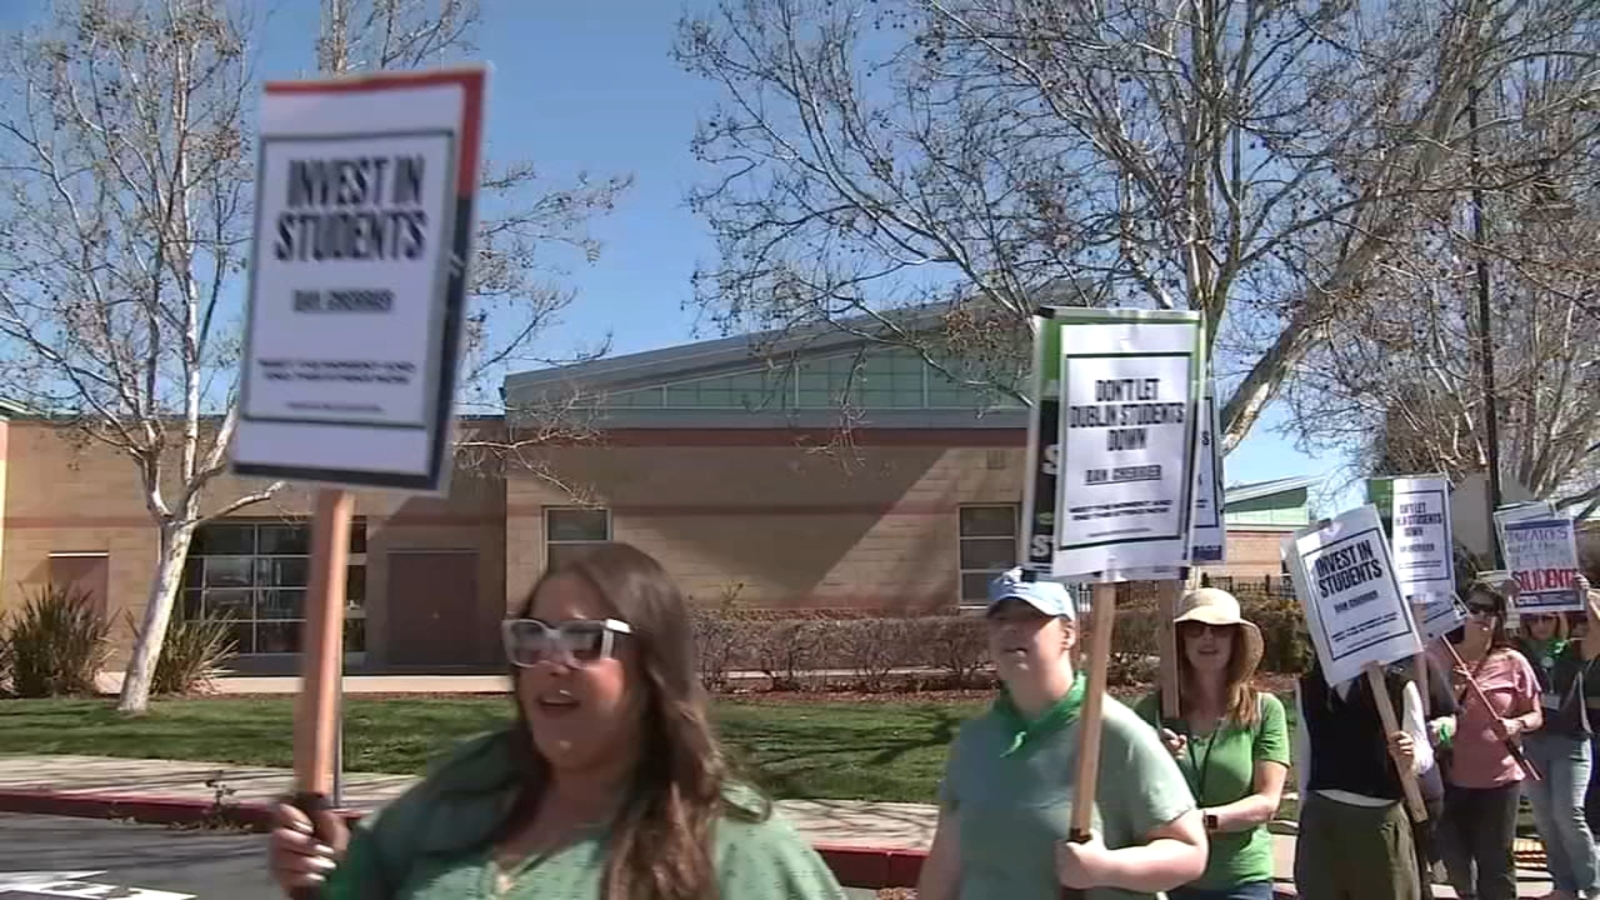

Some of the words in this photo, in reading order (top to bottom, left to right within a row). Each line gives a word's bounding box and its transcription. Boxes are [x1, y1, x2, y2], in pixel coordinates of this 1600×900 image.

[287, 158, 389, 206] INVEST
[393, 155, 426, 204] IN
[275, 211, 429, 261] STUDENTS
[1095, 379, 1134, 401] DON'T
[1136, 378, 1160, 400] LET
[1069, 404, 1118, 428] DUBLIN
[1120, 402, 1185, 426] STUDENTS
[1107, 428, 1148, 451] DOWN
[1315, 543, 1360, 578] INVEST
[1357, 539, 1375, 561] IN
[1318, 559, 1383, 598] STUDENTS
